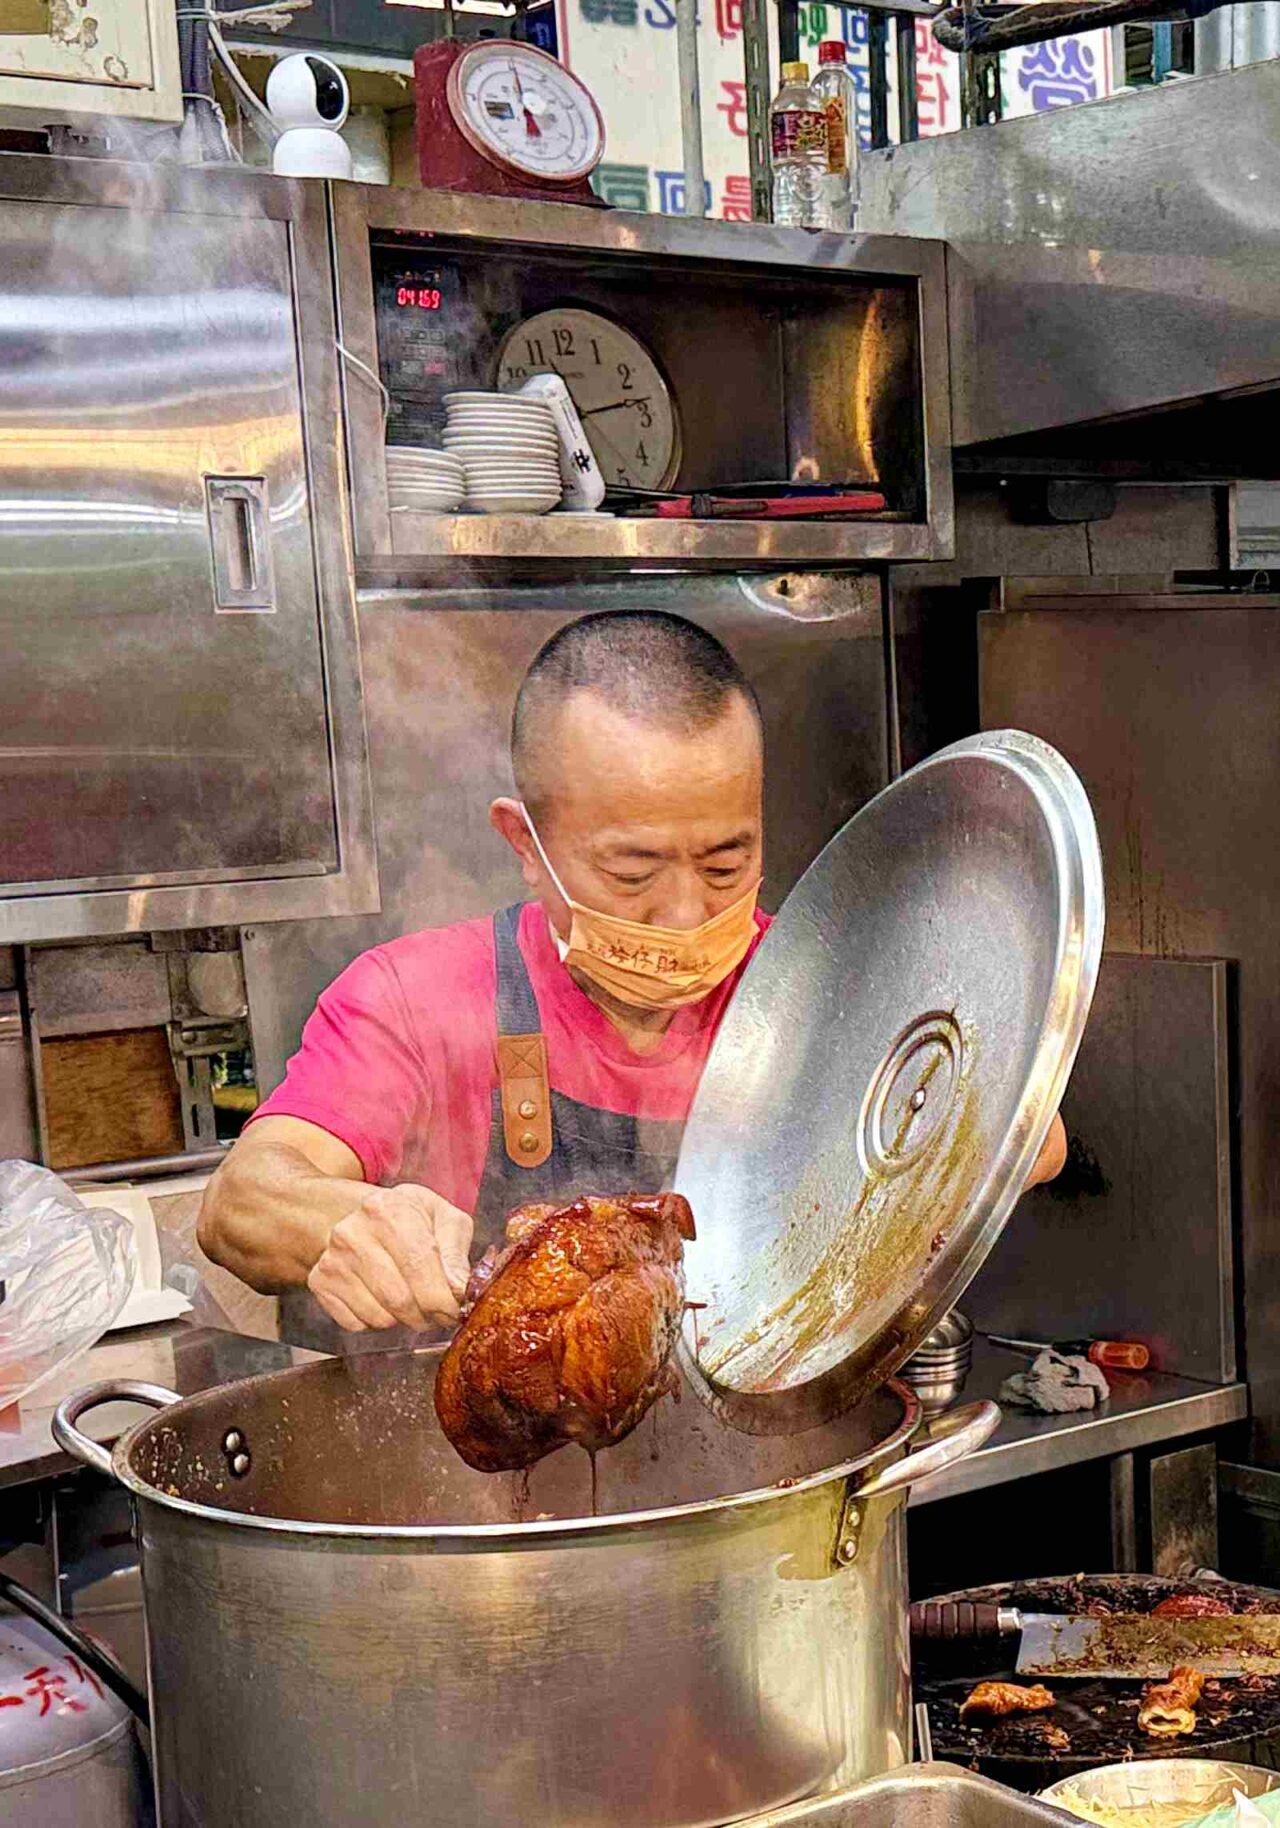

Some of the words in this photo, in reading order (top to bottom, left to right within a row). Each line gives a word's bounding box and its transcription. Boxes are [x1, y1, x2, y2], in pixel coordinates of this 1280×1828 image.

[525, 339, 547, 366] 11
[552, 328, 575, 356] 12
[590, 338, 602, 365] 1
[617, 363, 633, 390] 2
[637, 401, 653, 428] 3
[635, 440, 649, 467] 4
